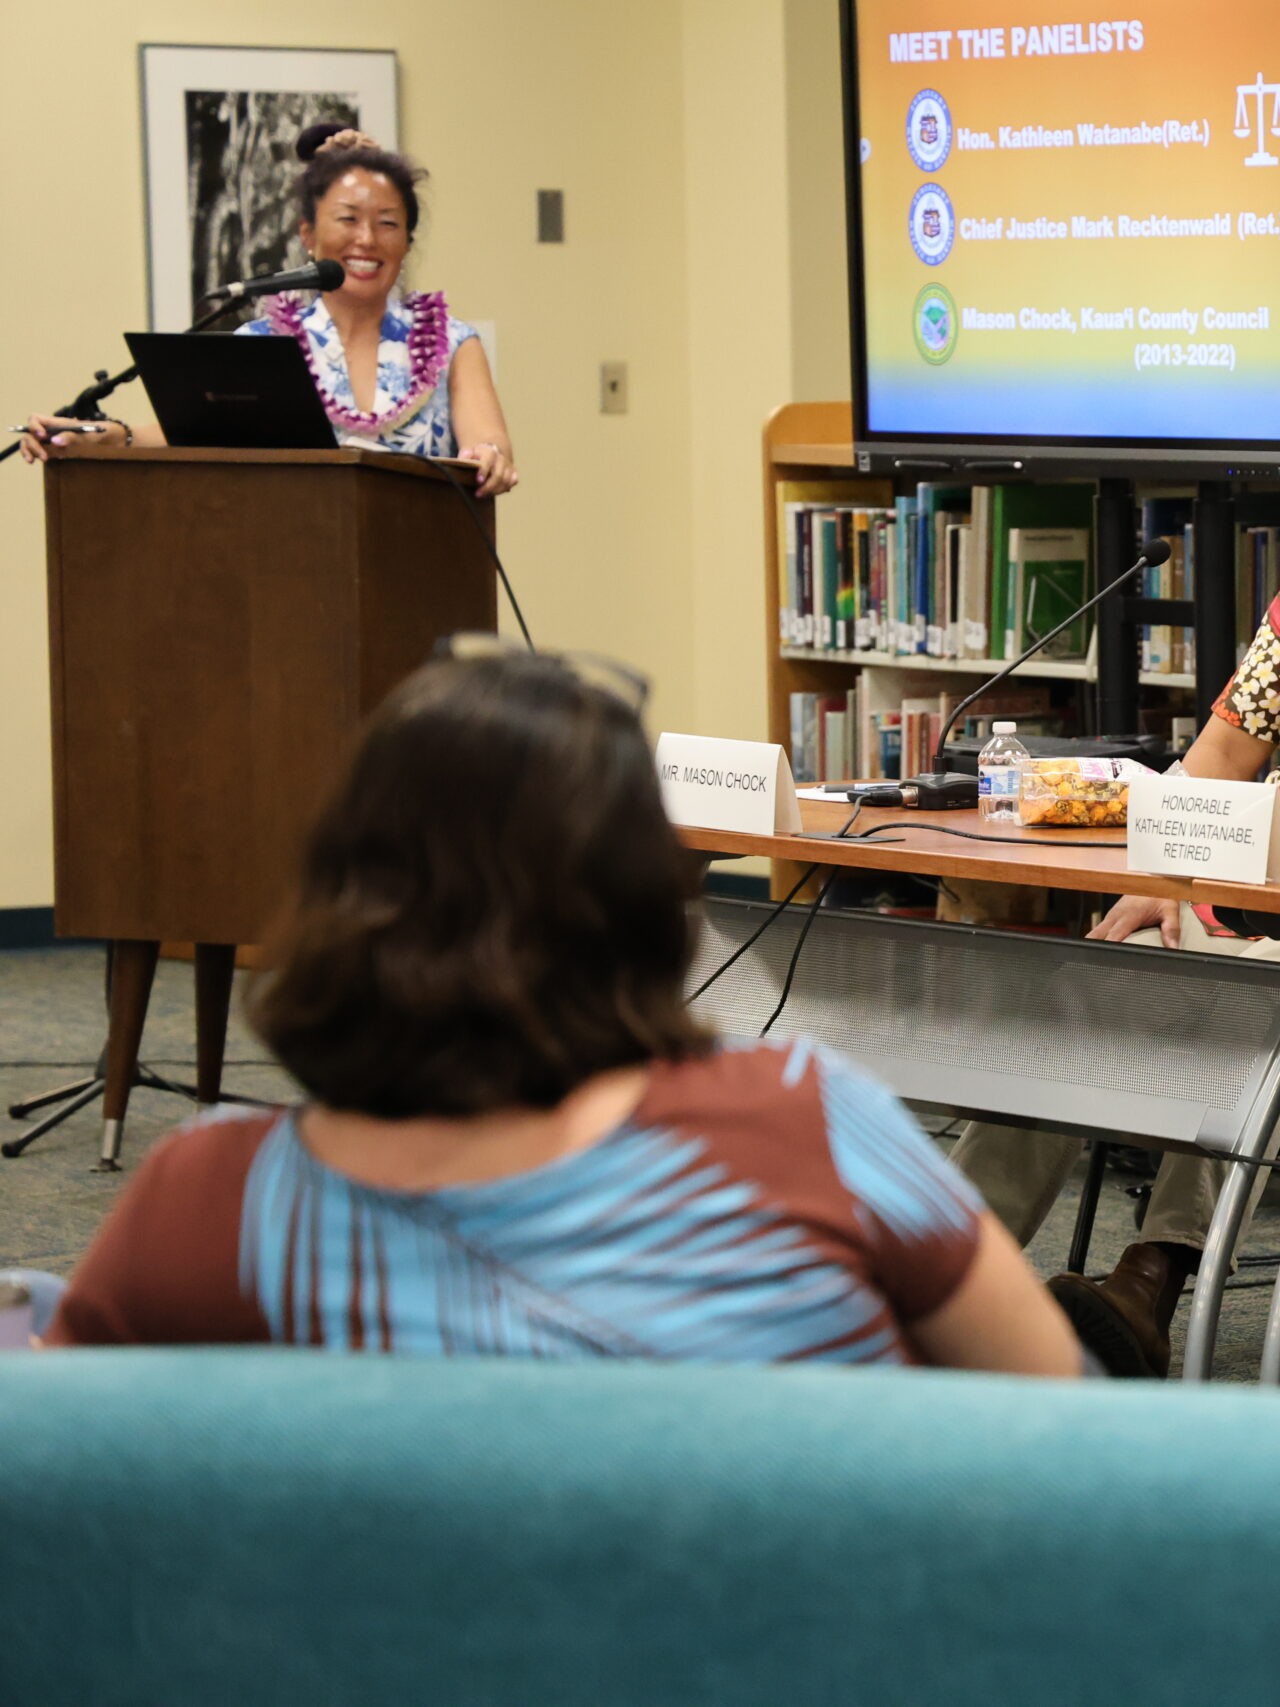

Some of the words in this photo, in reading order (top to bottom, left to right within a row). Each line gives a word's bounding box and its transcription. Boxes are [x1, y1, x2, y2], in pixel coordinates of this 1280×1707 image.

[889, 31, 952, 62] MEET
[957, 28, 1005, 59] THE
[1011, 20, 1144, 56] PANELISTS
[957, 128, 995, 150] Hon.
[999, 126, 1074, 148] Kathleen
[960, 218, 1003, 240] Chief
[1006, 217, 1067, 239] Justice
[1072, 216, 1114, 238] Mark
[1118, 213, 1231, 237] Recktenwald
[962, 308, 1016, 329] Mason
[1019, 307, 1077, 333] Chock,
[1138, 307, 1198, 335] County
[1203, 306, 1270, 329] Council
[1134, 343, 1236, 371] (2013-2022)
[661, 764, 680, 782] MR.
[683, 766, 723, 787] MASON
[725, 771, 767, 792] CHOCK
[1162, 795, 1231, 816] HONORABLE
[1135, 818, 1186, 837] KATHLEEN
[1190, 822, 1255, 846] WATANABE,
[1164, 842, 1212, 862] RETIRED
